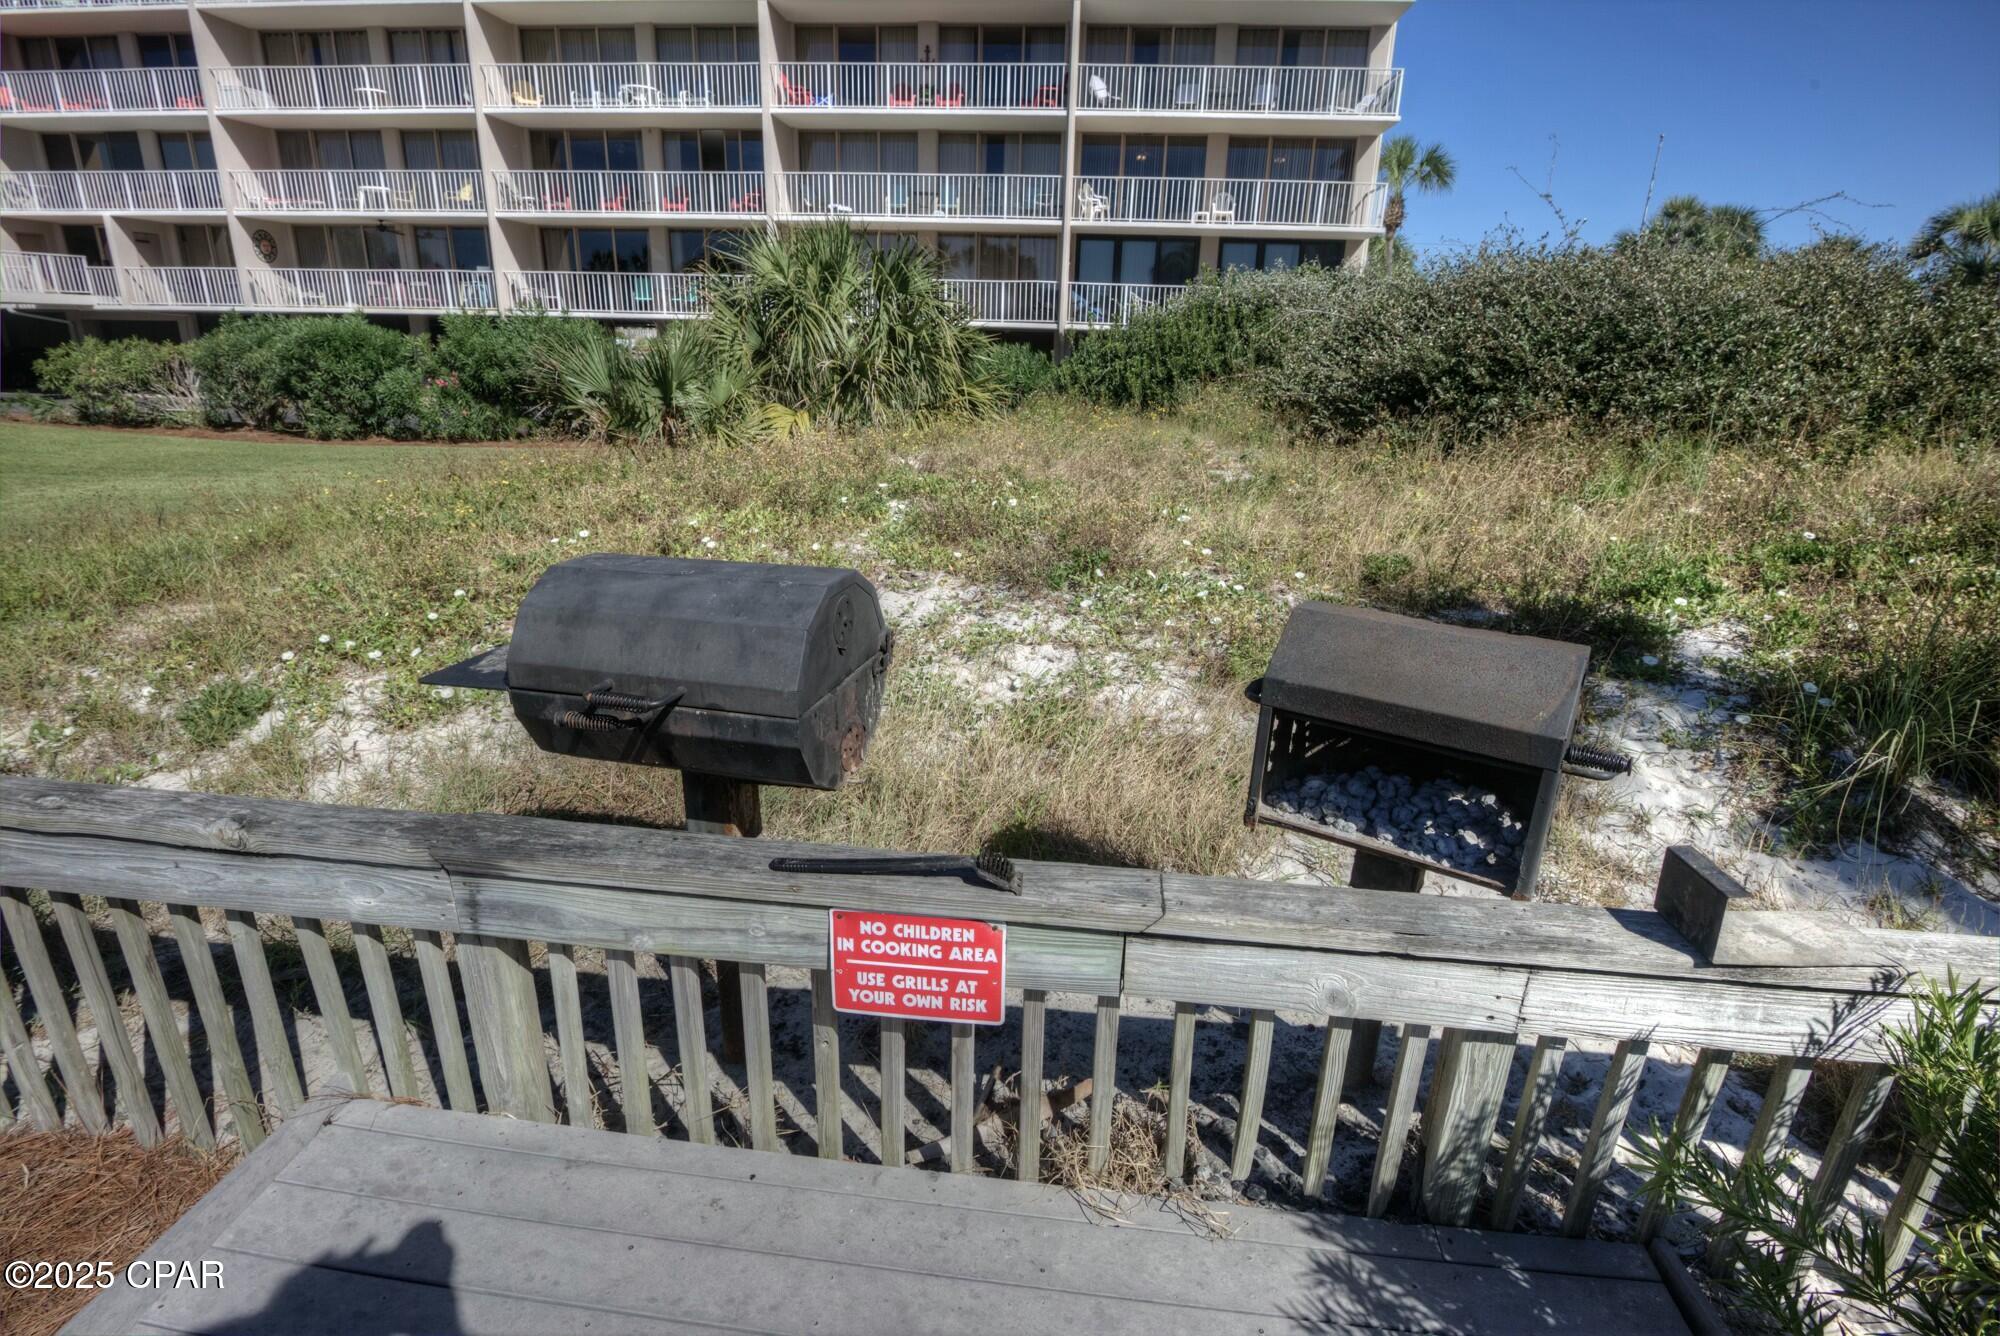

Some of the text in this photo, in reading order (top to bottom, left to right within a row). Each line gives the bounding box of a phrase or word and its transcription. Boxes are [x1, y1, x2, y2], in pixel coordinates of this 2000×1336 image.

[859, 920, 975, 944] NO CHILDREN
[837, 937, 999, 964] IN COOKING AREA
[856, 971, 978, 995] USE GRILLS AT
[848, 988, 988, 1013] YOUR OWN RISK
